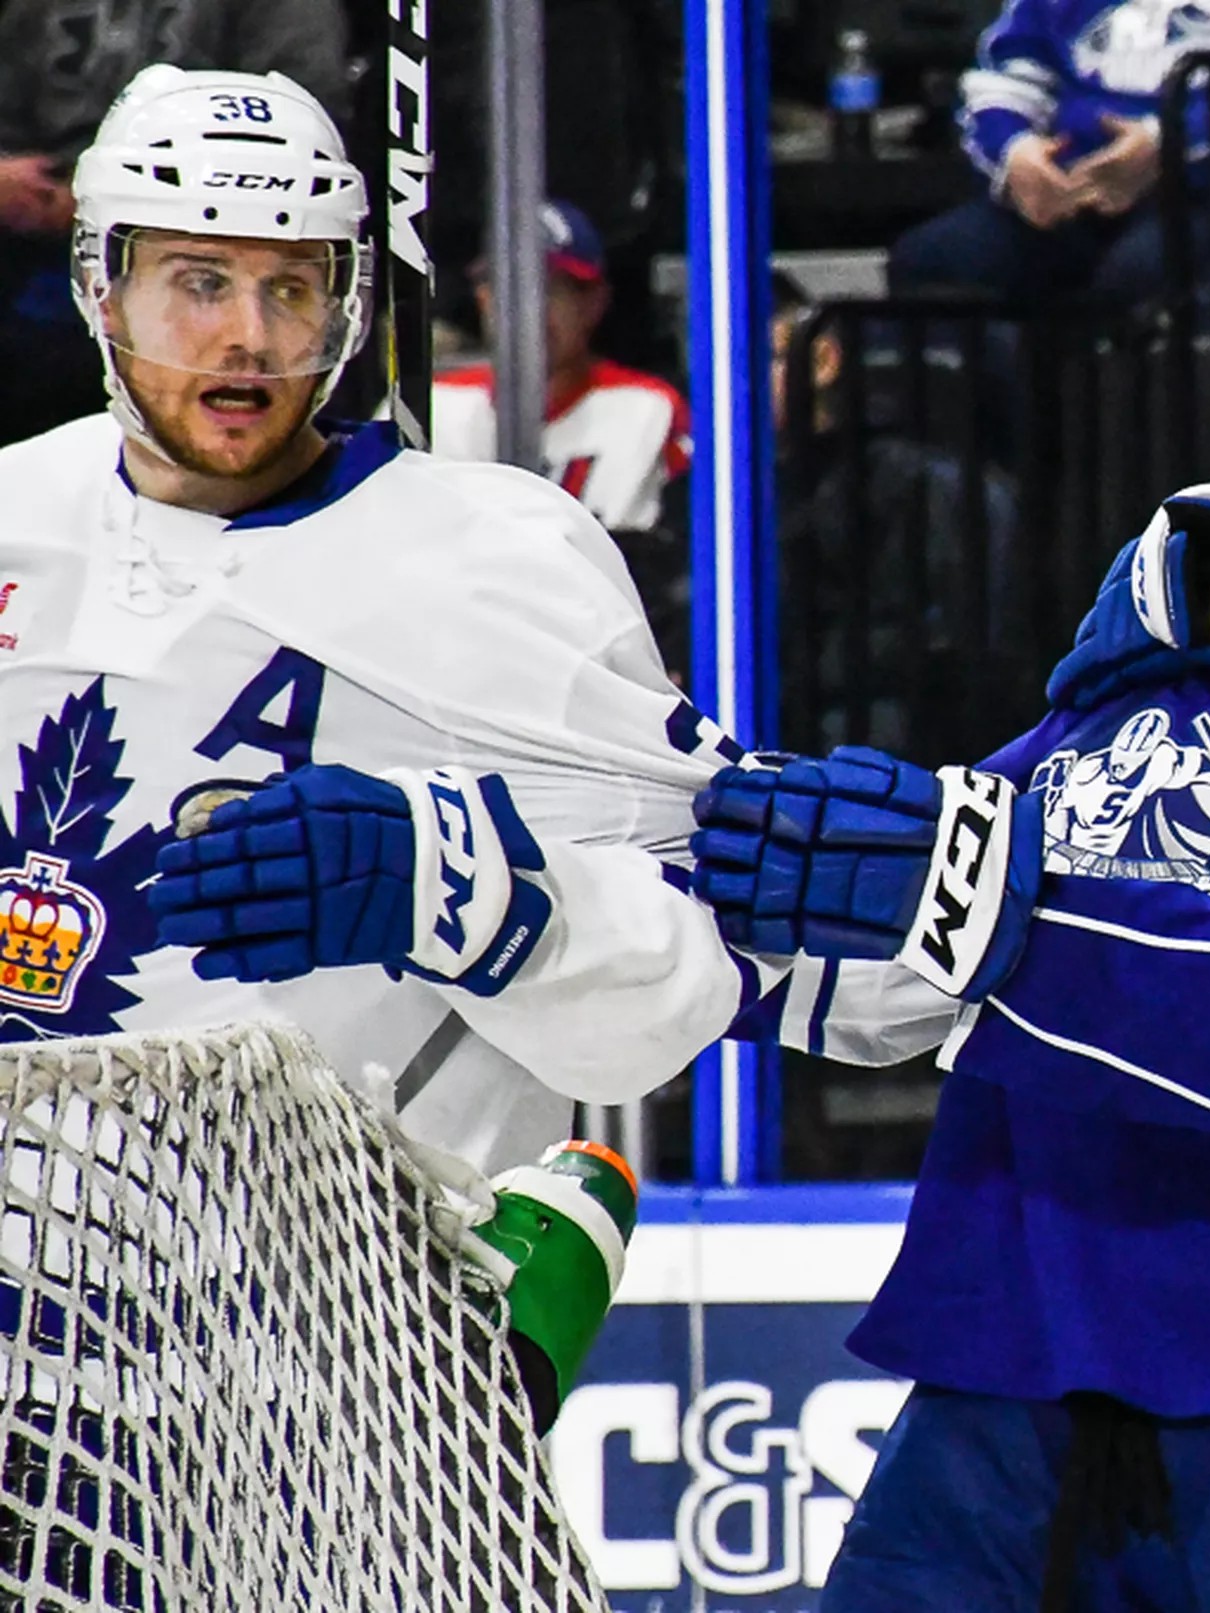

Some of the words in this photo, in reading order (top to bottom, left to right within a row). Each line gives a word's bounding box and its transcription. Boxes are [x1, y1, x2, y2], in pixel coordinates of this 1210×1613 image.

[209, 94, 273, 122] 38
[202, 171, 296, 191] CCM
[194, 645, 326, 773] A
